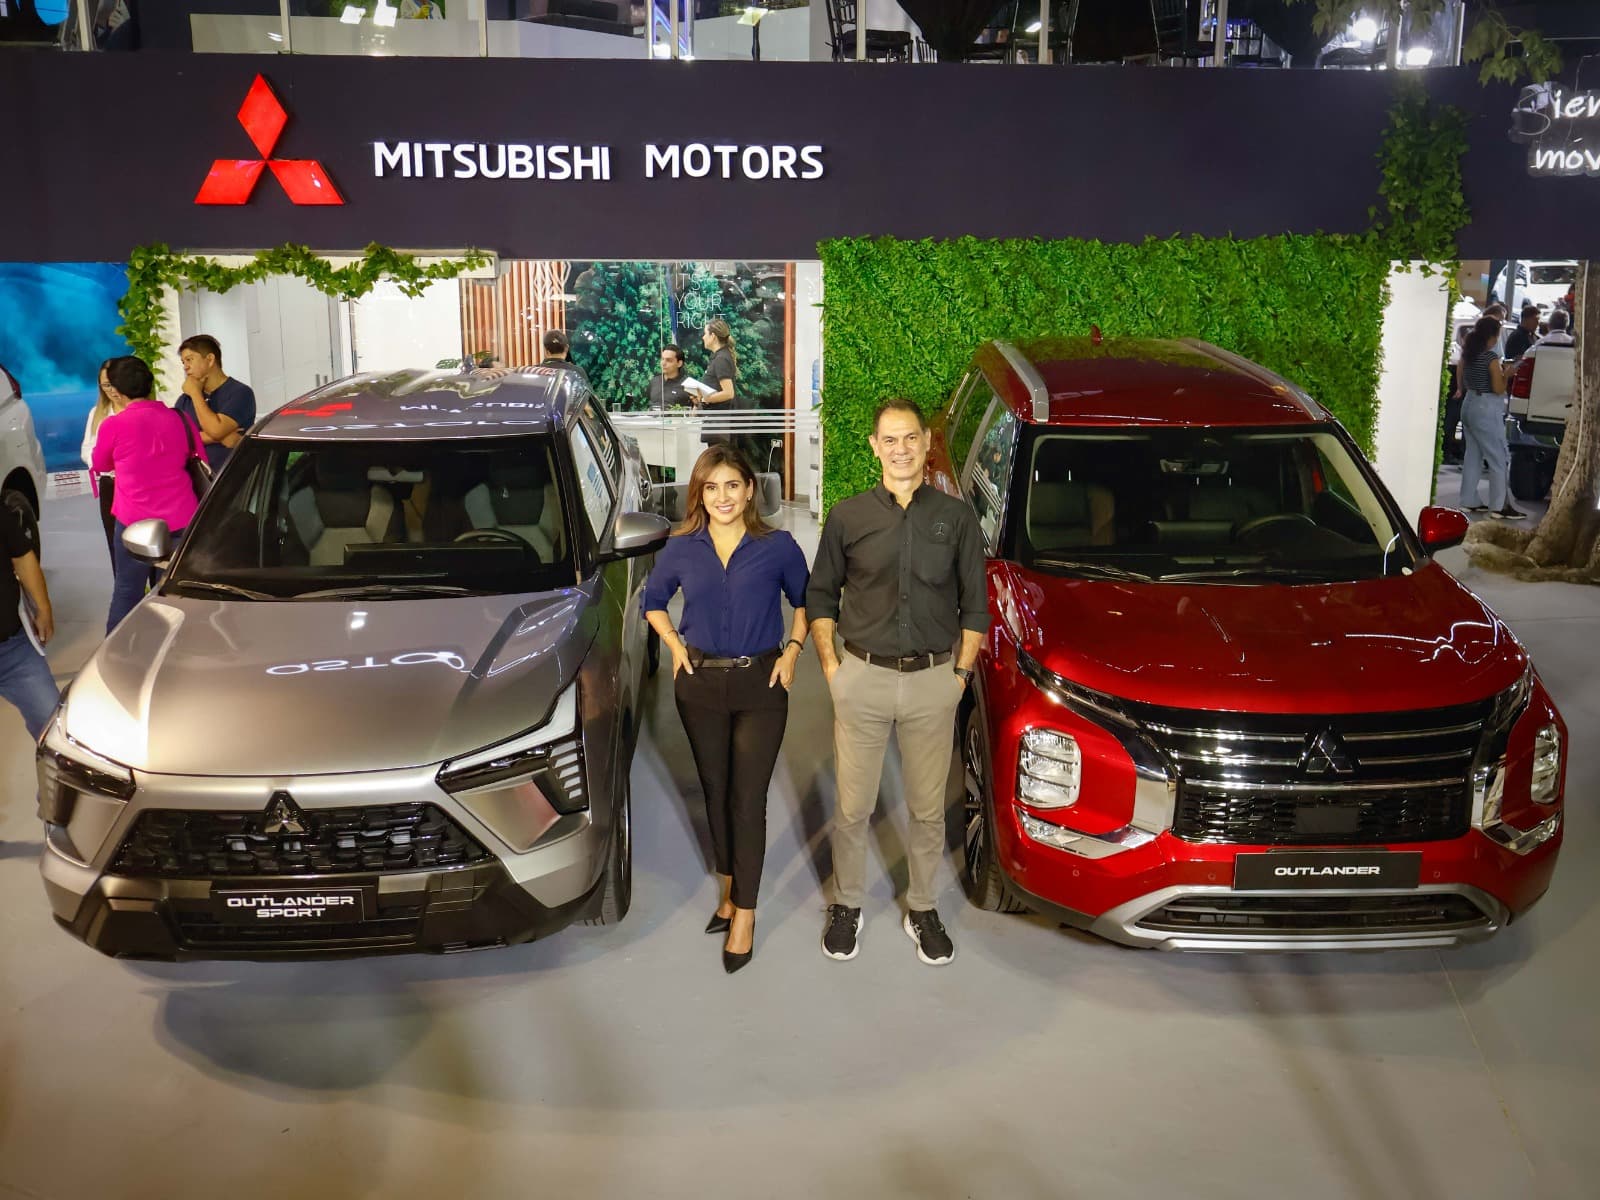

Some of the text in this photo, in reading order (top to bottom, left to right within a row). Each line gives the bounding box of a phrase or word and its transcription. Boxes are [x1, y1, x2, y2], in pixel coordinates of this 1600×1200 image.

[373, 141, 824, 180] MITSUBISHI MOTORS
[675, 292, 722, 311] YOUR
[1274, 866, 1380, 876] OUTLANDER
[226, 896, 355, 907] OUTLANDER
[256, 908, 326, 918] SPORT
